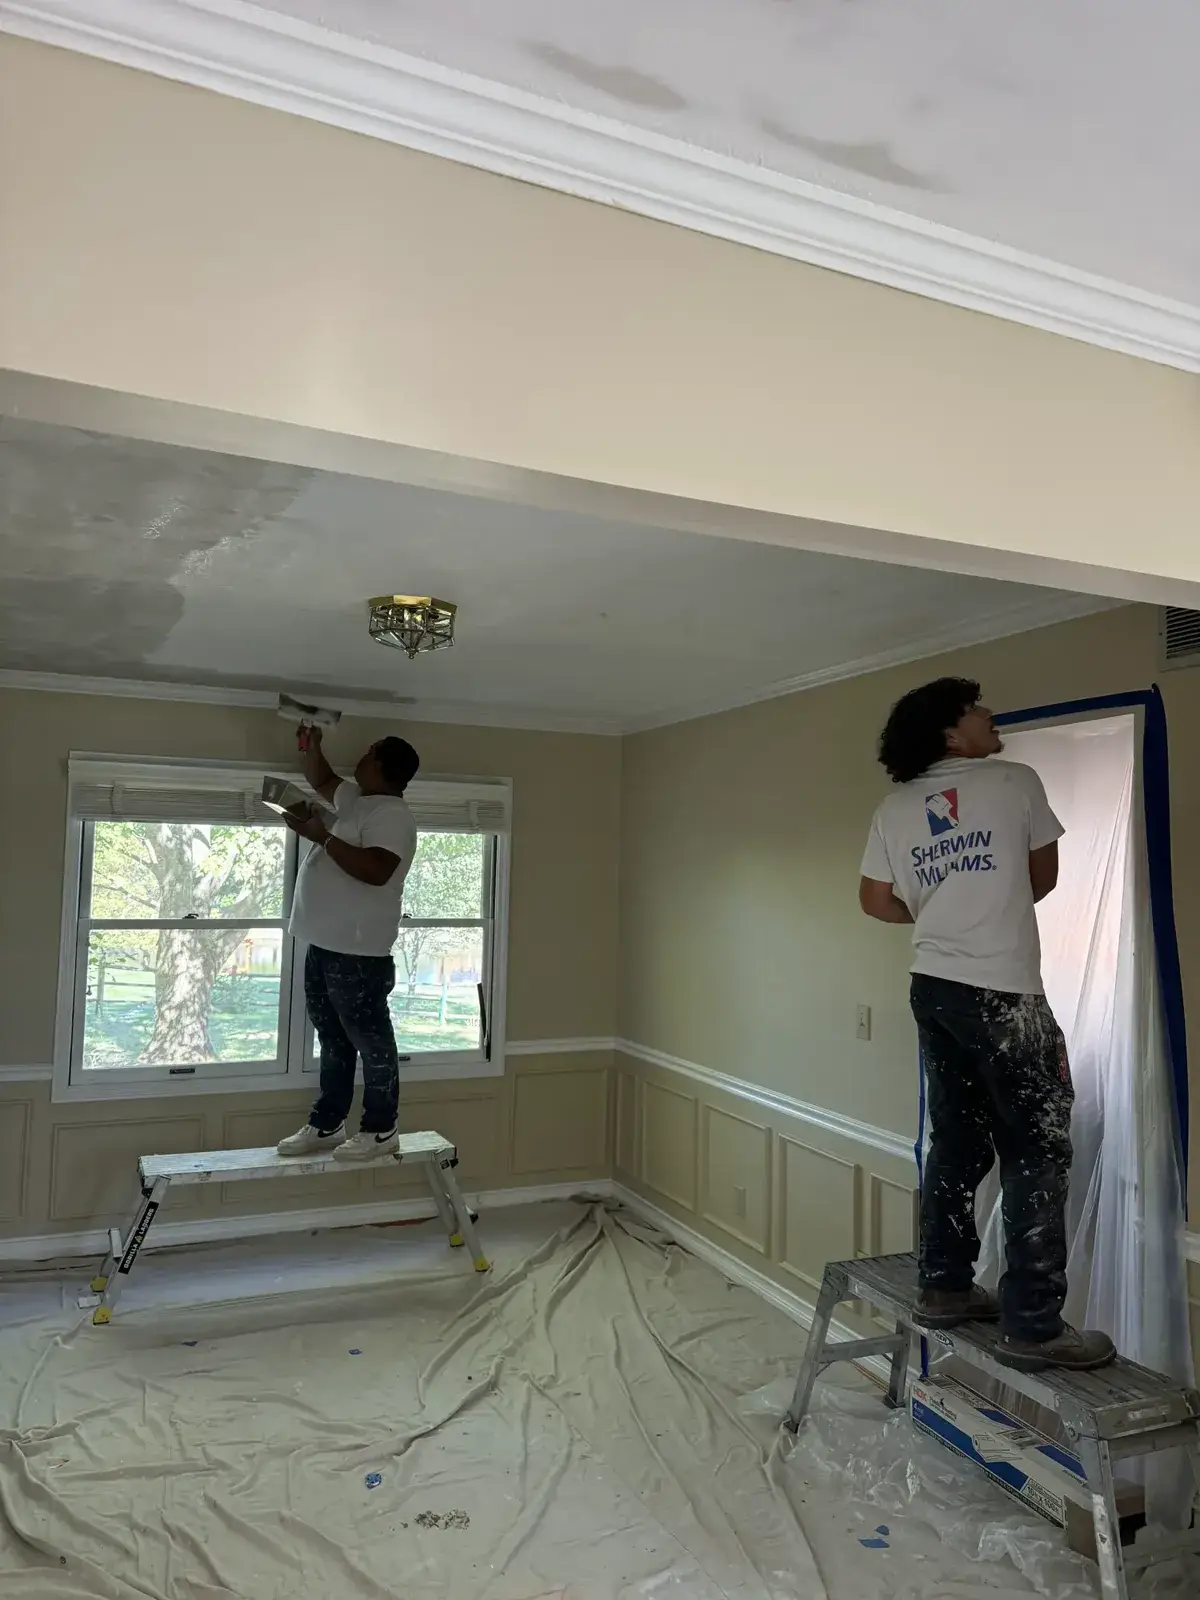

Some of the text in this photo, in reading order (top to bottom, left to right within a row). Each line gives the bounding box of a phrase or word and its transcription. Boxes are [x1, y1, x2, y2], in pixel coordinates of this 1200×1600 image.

[911, 830, 992, 868] SHERWIN
[123, 1208, 154, 1269] GORILLA LADDERS
